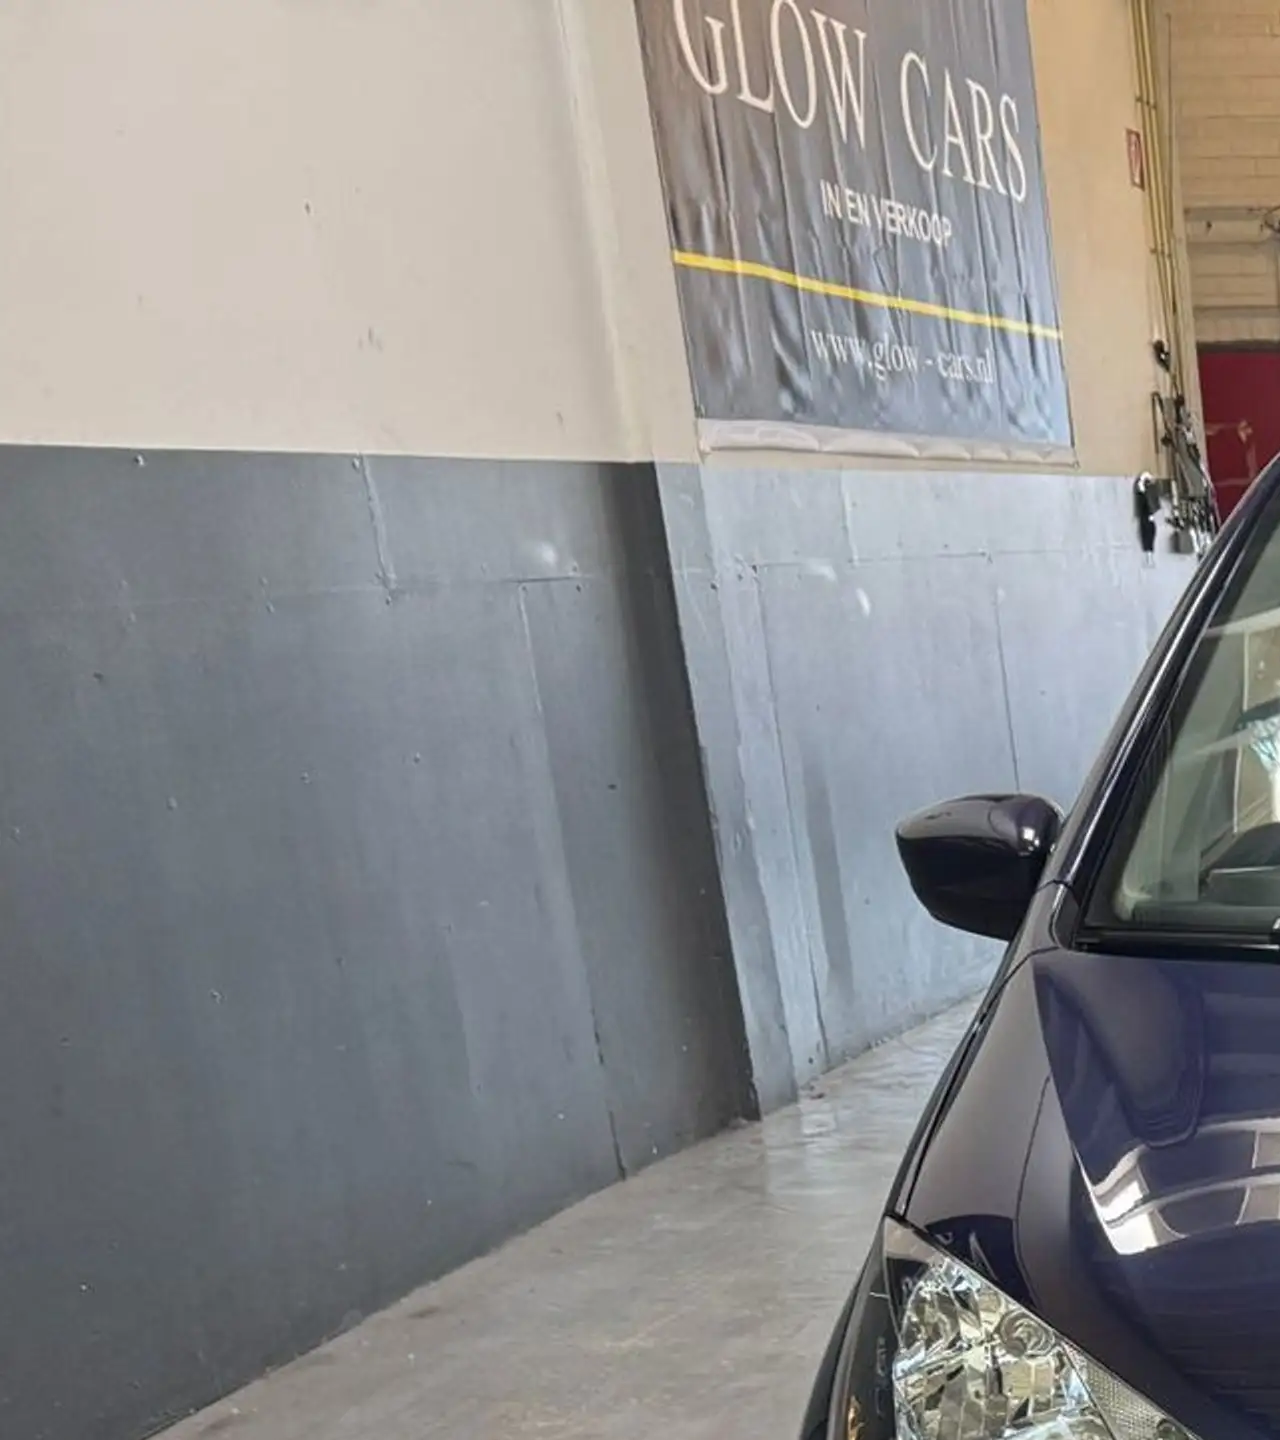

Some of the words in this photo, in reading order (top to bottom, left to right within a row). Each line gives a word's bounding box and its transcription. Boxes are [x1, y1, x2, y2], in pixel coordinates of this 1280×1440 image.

[673, 0, 867, 149] GLOW
[900, 51, 1026, 203] CARS
[820, 179, 842, 219] IN
[845, 188, 872, 228] EN
[872, 194, 952, 248] VERKOOP
